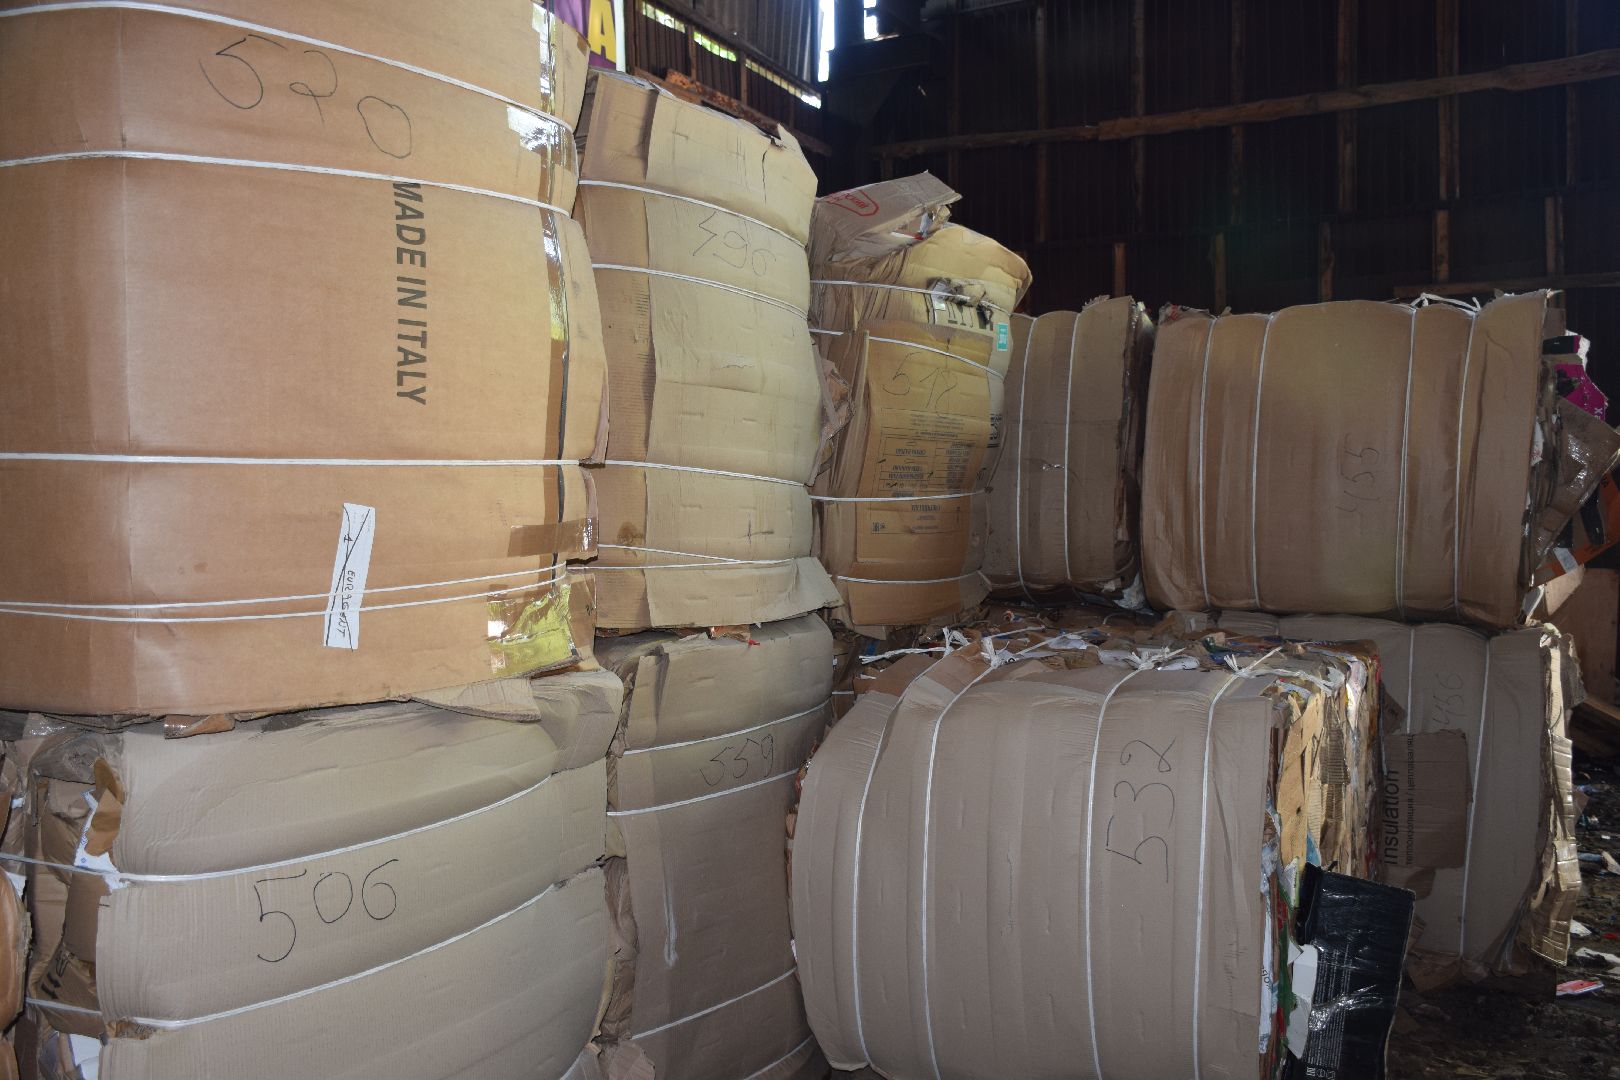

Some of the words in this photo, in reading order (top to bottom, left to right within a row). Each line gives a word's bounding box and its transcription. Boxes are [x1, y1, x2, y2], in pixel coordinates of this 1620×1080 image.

[198, 34, 413, 160] 520
[393, 182, 427, 268] MADE
[396, 276, 428, 309] IN
[396, 318, 428, 405] ITALY
[1105, 736, 1178, 883] 532
[1381, 769, 1400, 865] insulation
[253, 858, 400, 963] 506
